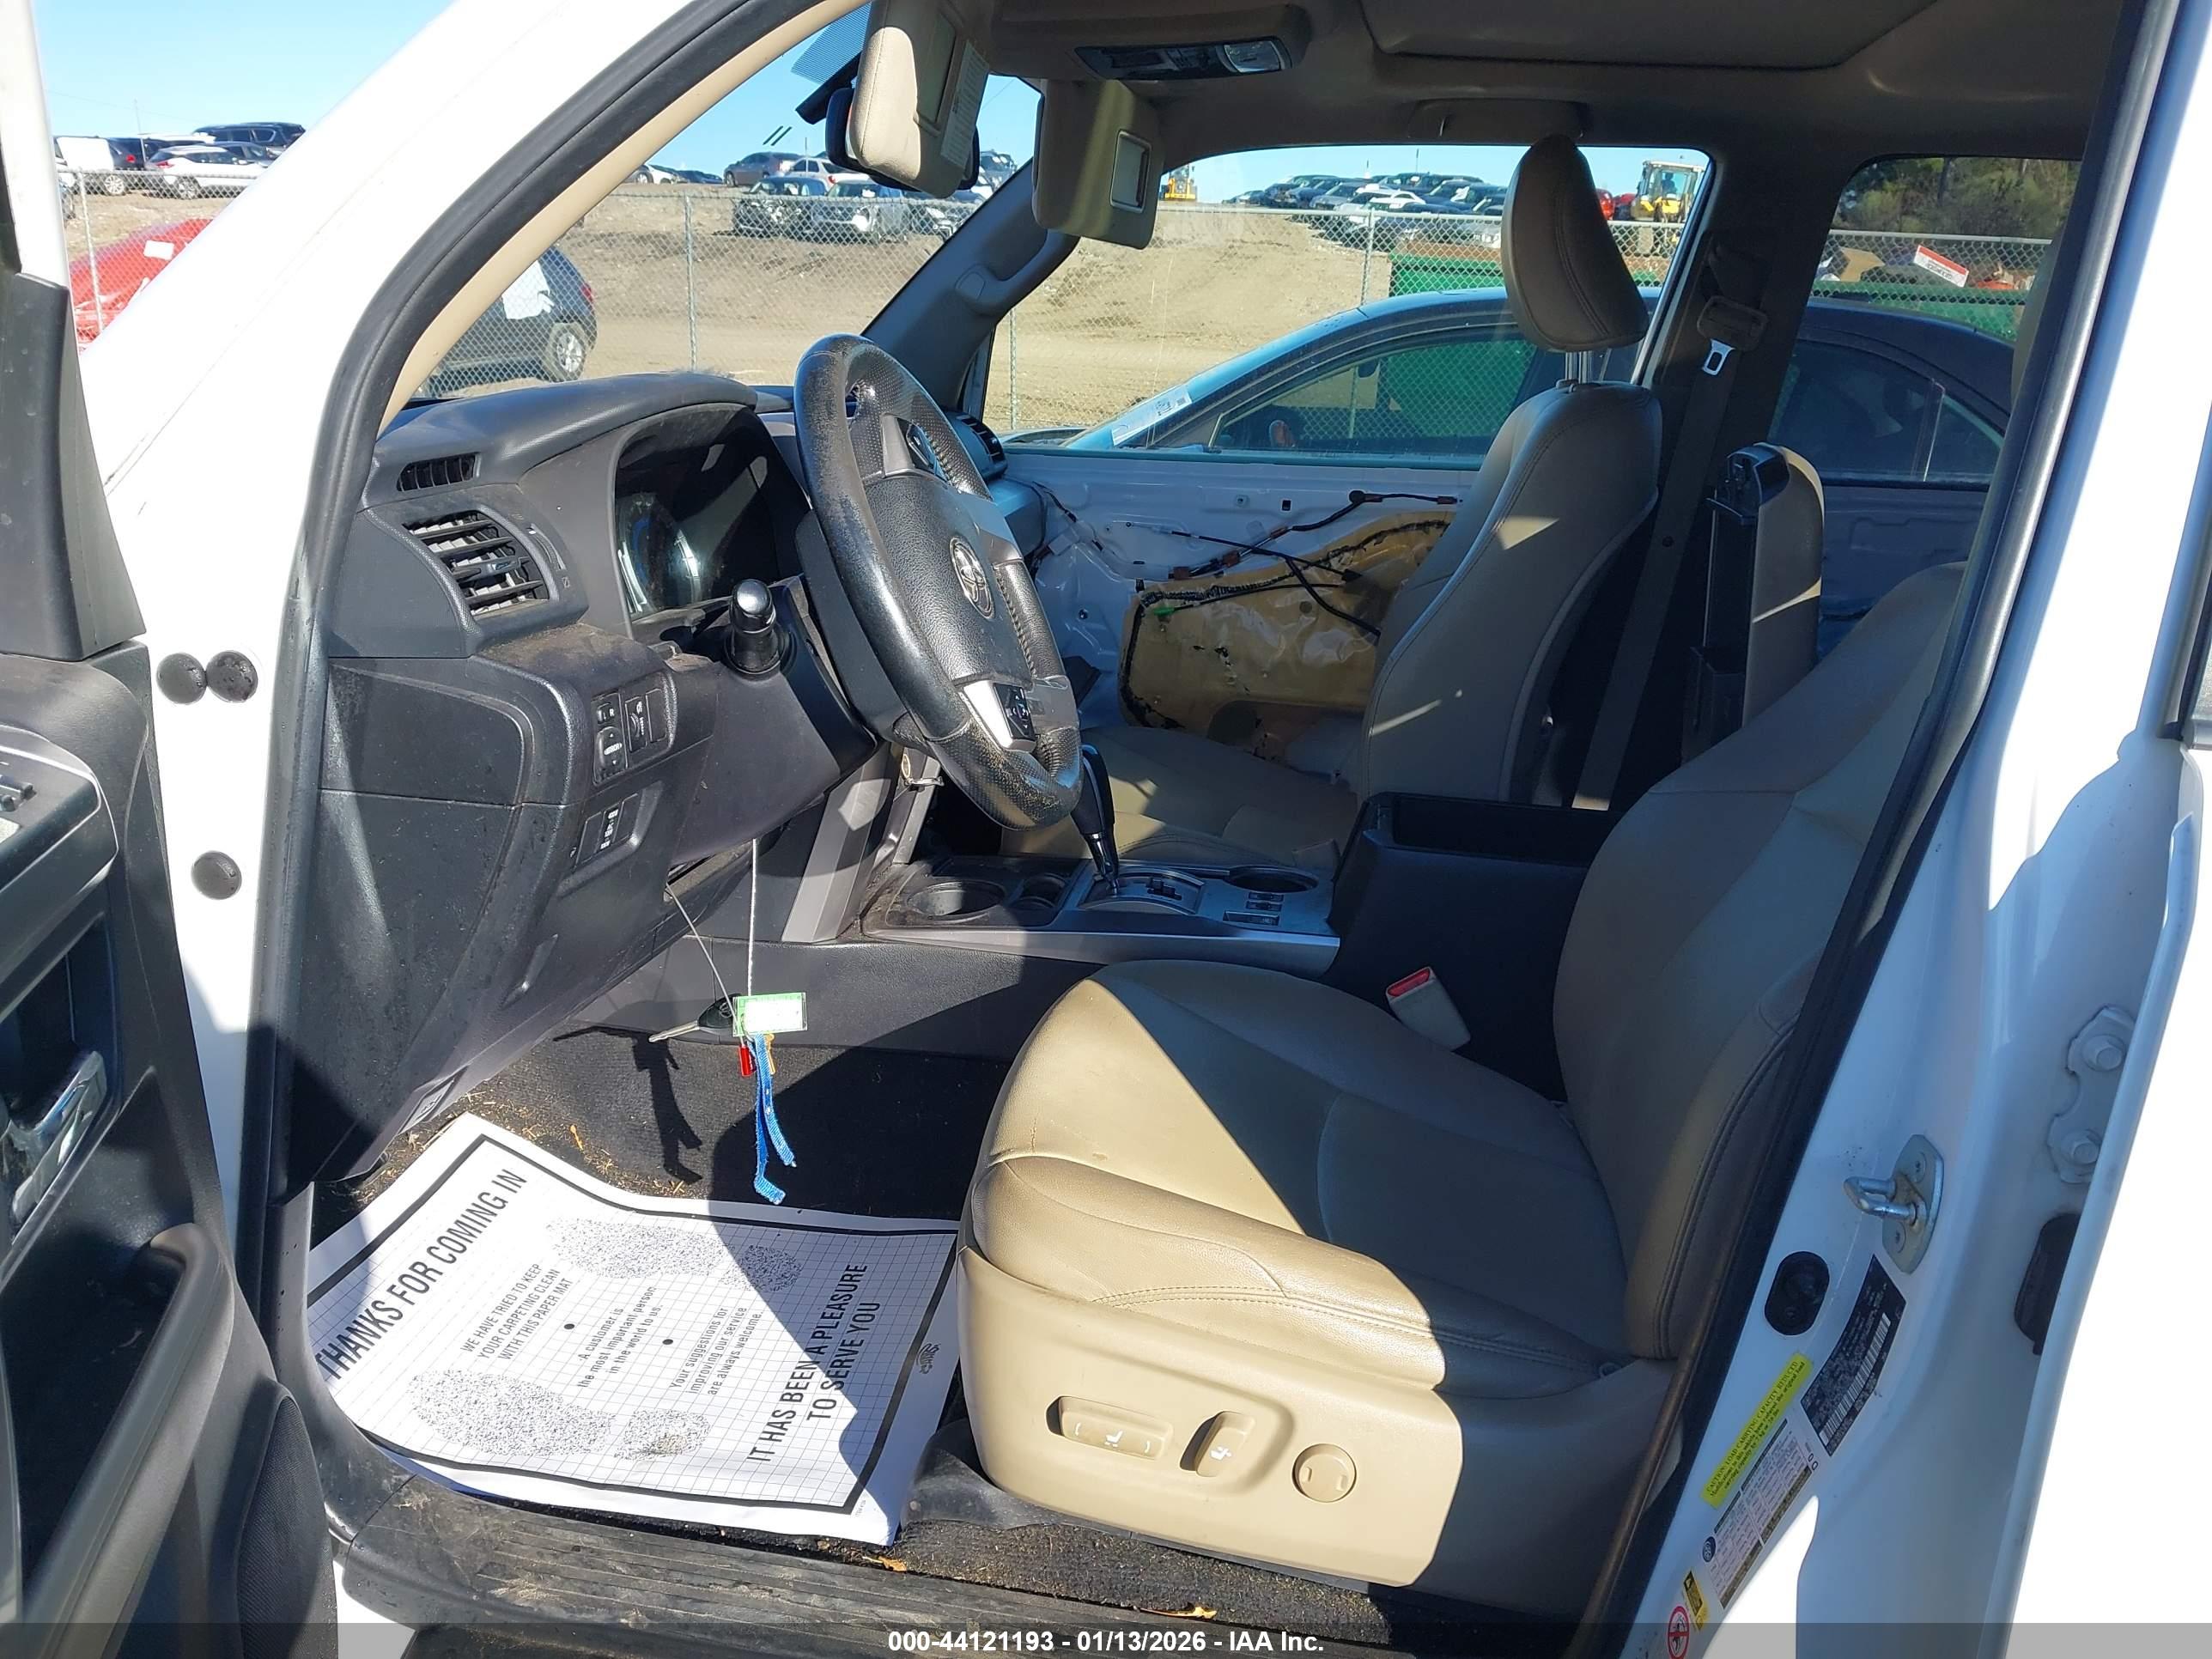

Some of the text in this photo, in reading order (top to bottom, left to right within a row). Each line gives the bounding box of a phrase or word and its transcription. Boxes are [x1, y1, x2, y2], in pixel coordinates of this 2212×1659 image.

[315, 1169, 527, 1380] THANKS FOR COMING IN
[460, 1263, 542, 1352] WE HAVE TRIED TO KEEP
[477, 1268, 560, 1358] YOUR CARPETING CLEAN
[498, 1278, 573, 1359] WITH THIS PAPER MAT
[577, 1286, 657, 1388] the most important person
[586, 1316, 617, 1352] customer
[605, 1365, 621, 1374] in
[614, 1350, 631, 1364] the
[625, 1328, 647, 1348] world
[669, 1308, 728, 1388] Your suggestions for
[687, 1307, 747, 1394] improving our service
[708, 1311, 763, 1395] are always welcome.
[746, 1264, 868, 1462] IT HAS BEEN A PLEASURE
[806, 1303, 880, 1420] TO SERVE YOU
[1724, 1449, 1737, 1465] LOAD
[1757, 1390, 1778, 1419] CAPACITY
[1777, 1361, 1798, 1389] REDUCED
